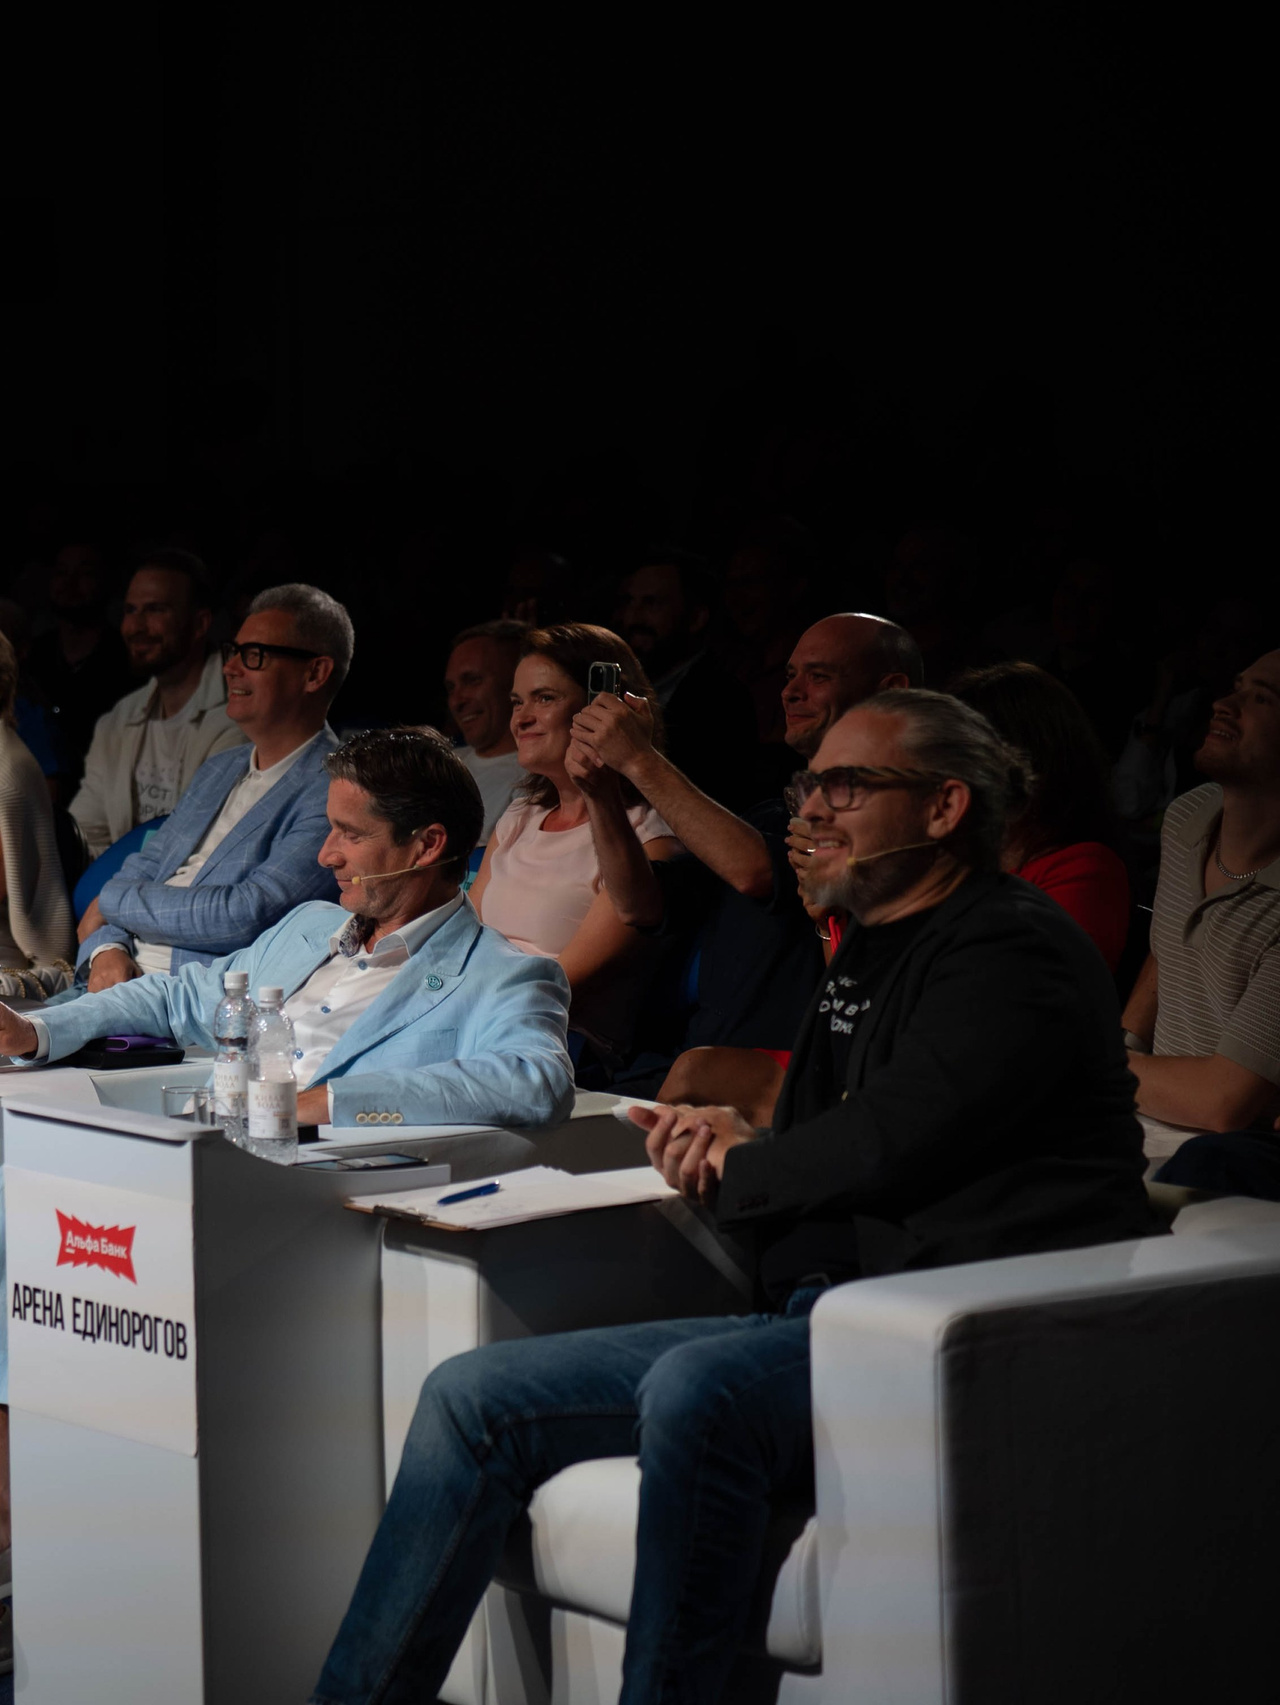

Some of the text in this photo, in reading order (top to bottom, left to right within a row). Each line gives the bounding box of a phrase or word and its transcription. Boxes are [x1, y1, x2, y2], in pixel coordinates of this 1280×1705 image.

[65, 1231, 127, 1259] Альфа Банк
[12, 1282, 188, 1360] АРЕНА ЕДИНОРОГОВ
